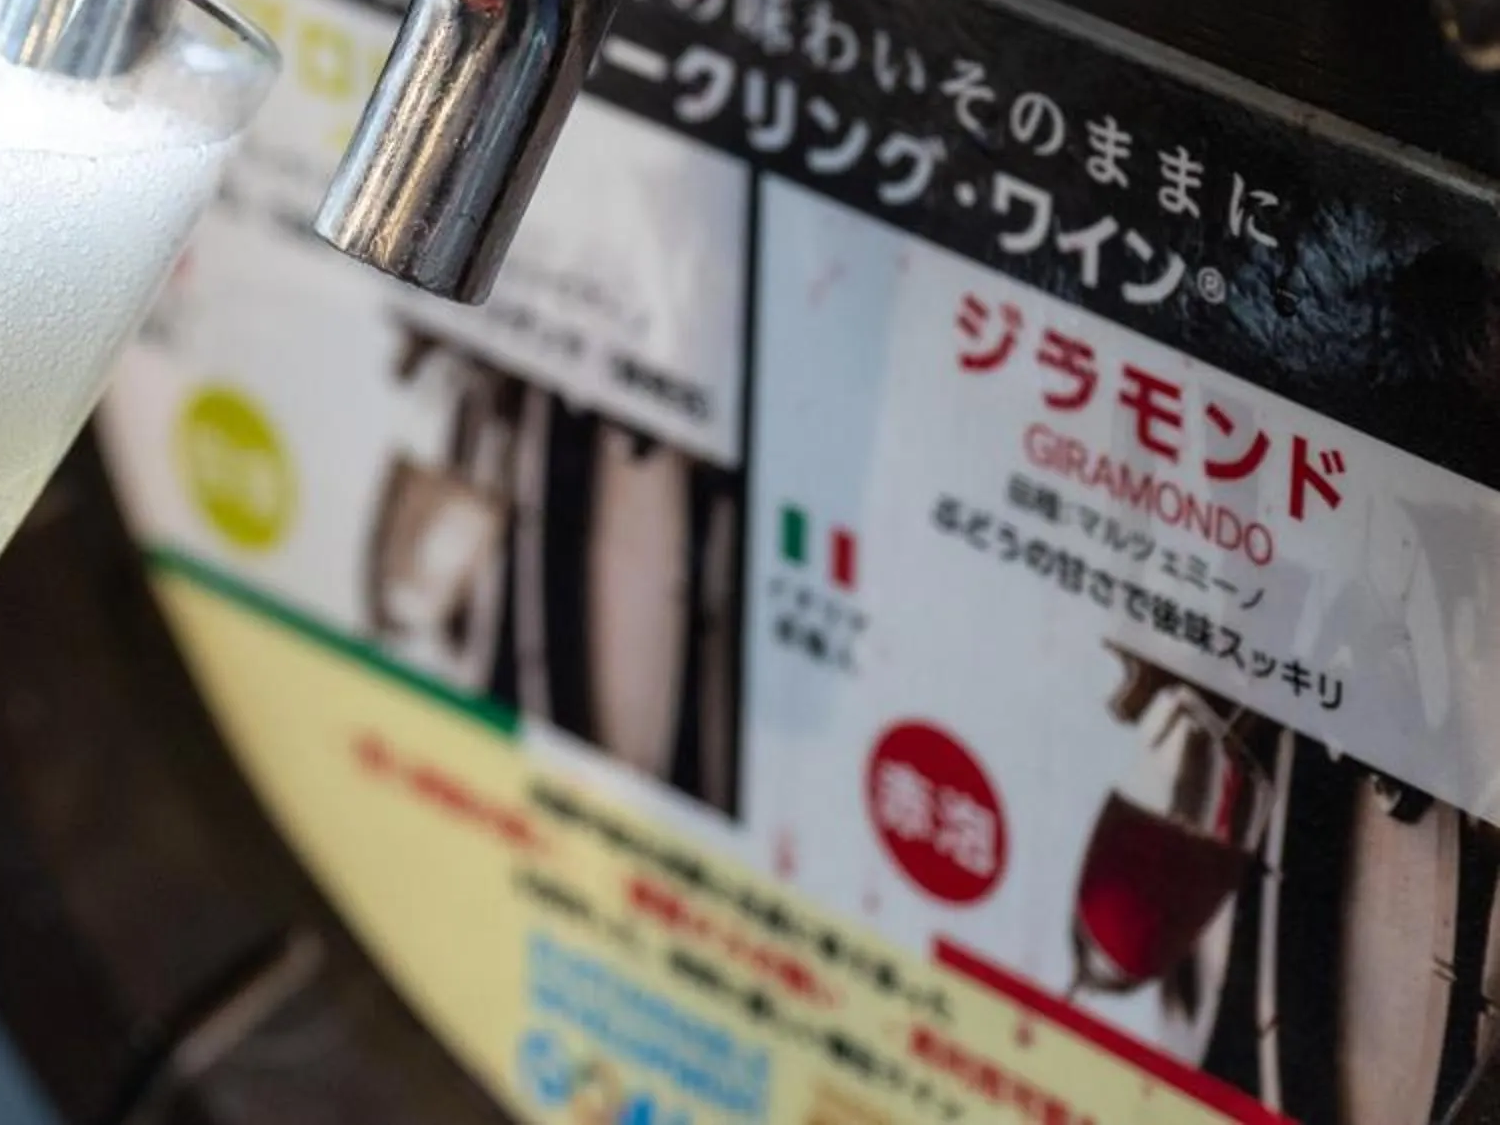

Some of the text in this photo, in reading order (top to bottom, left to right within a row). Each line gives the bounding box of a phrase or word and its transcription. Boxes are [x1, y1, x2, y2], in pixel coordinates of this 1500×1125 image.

[955, 291, 1347, 522] ジラモンド
[1022, 422, 1276, 567] GIRAMONDO
